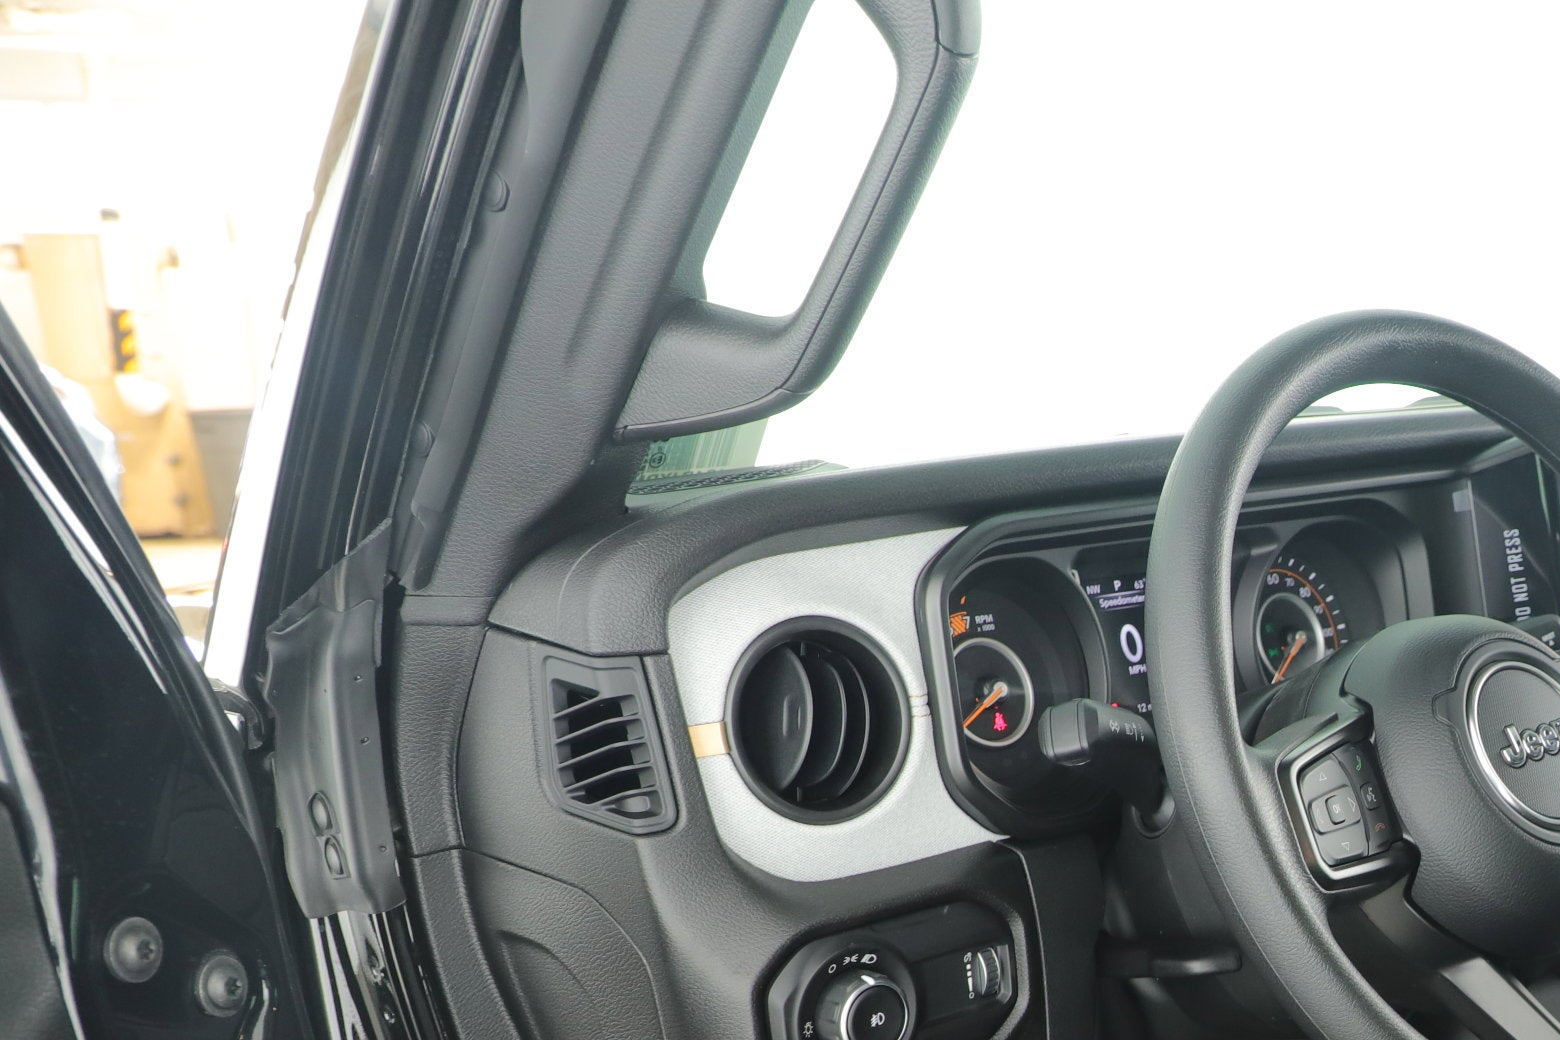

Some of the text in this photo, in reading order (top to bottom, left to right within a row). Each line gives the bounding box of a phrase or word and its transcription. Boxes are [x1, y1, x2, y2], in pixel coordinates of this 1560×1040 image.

[1503, 528, 1525, 573] PRESS
[1113, 579, 1121, 592] P
[1266, 573, 1280, 586] 60
[1285, 577, 1295, 588] 70
[1086, 584, 1100, 595] NW
[1299, 587, 1312, 599] 80
[1510, 577, 1529, 603] NOT
[962, 615, 971, 630] 7
[974, 614, 994, 625] RPM
[1120, 623, 1143, 664] 0
[1128, 664, 1147, 676] MPH
